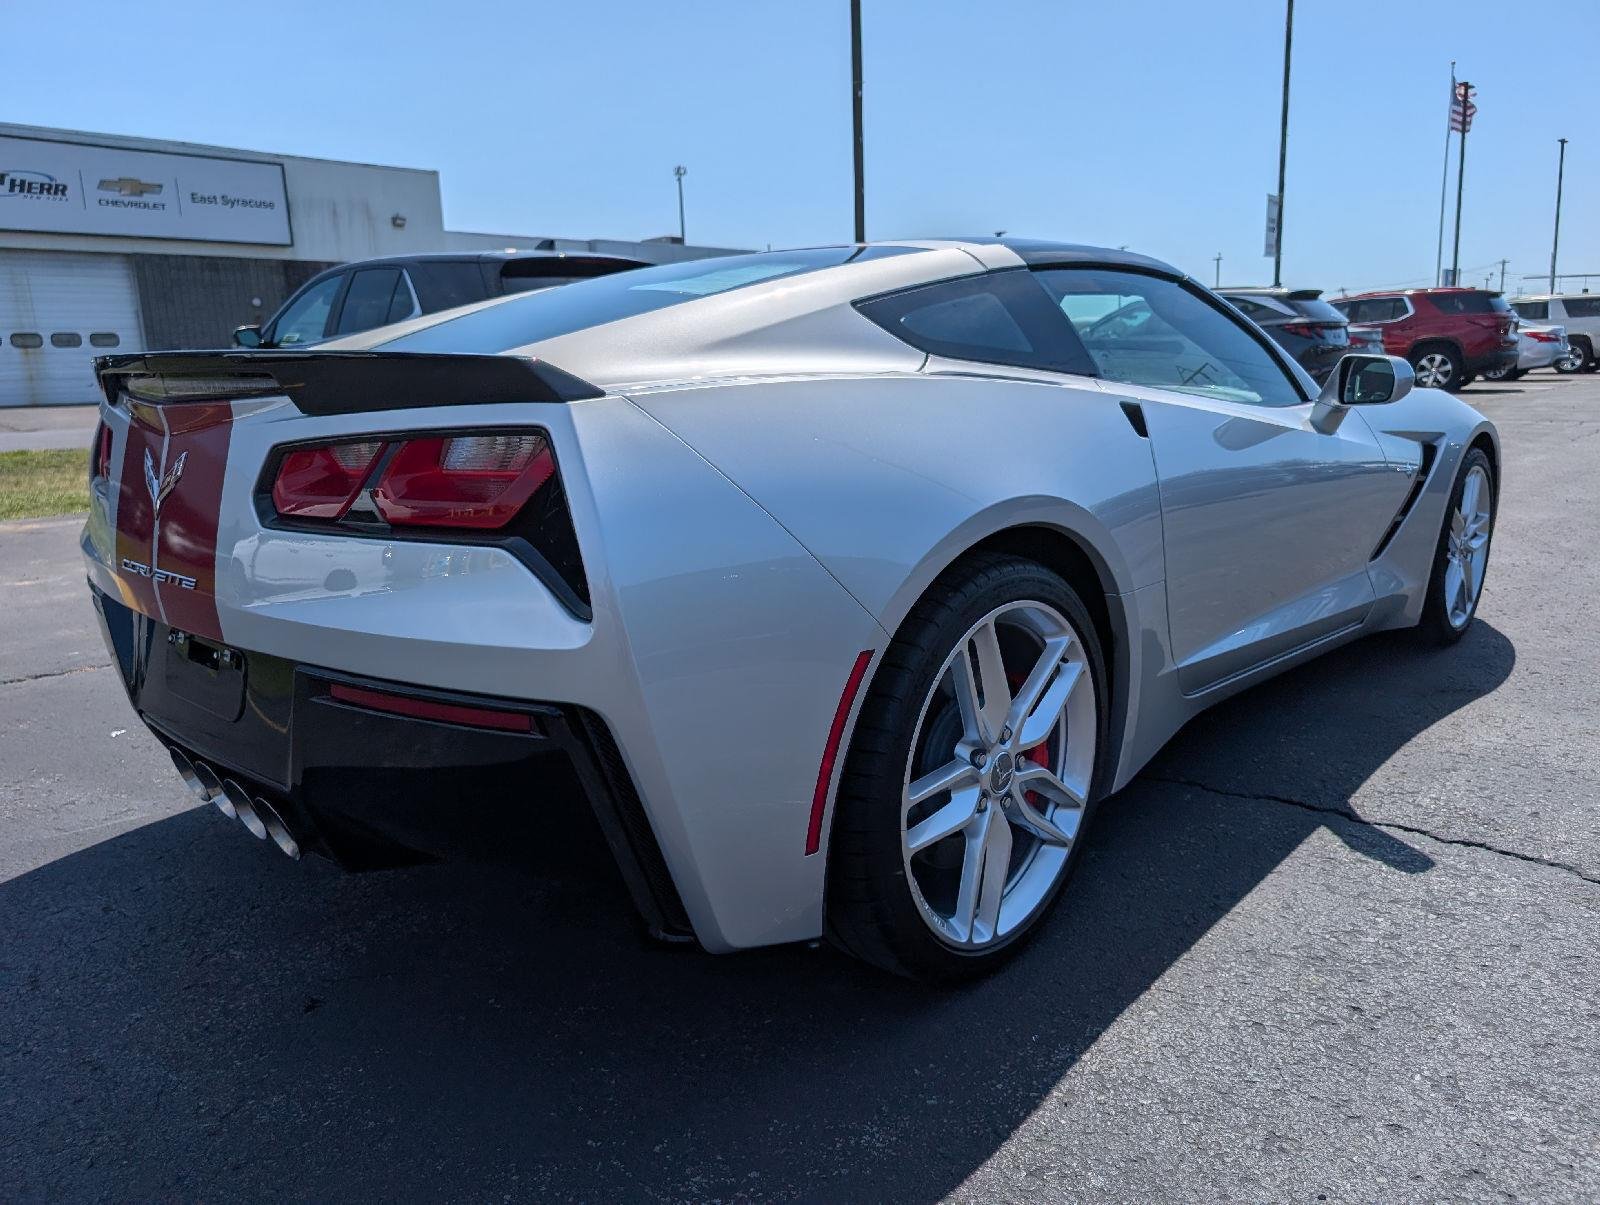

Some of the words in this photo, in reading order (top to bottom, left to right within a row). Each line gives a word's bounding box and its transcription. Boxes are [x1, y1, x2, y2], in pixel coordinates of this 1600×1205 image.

[9, 178, 68, 197] HERR
[99, 199, 166, 211] CHEVROLET
[191, 192, 218, 205] East
[221, 195, 276, 209] Syracuse
[121, 558, 197, 590] CORVETTE
